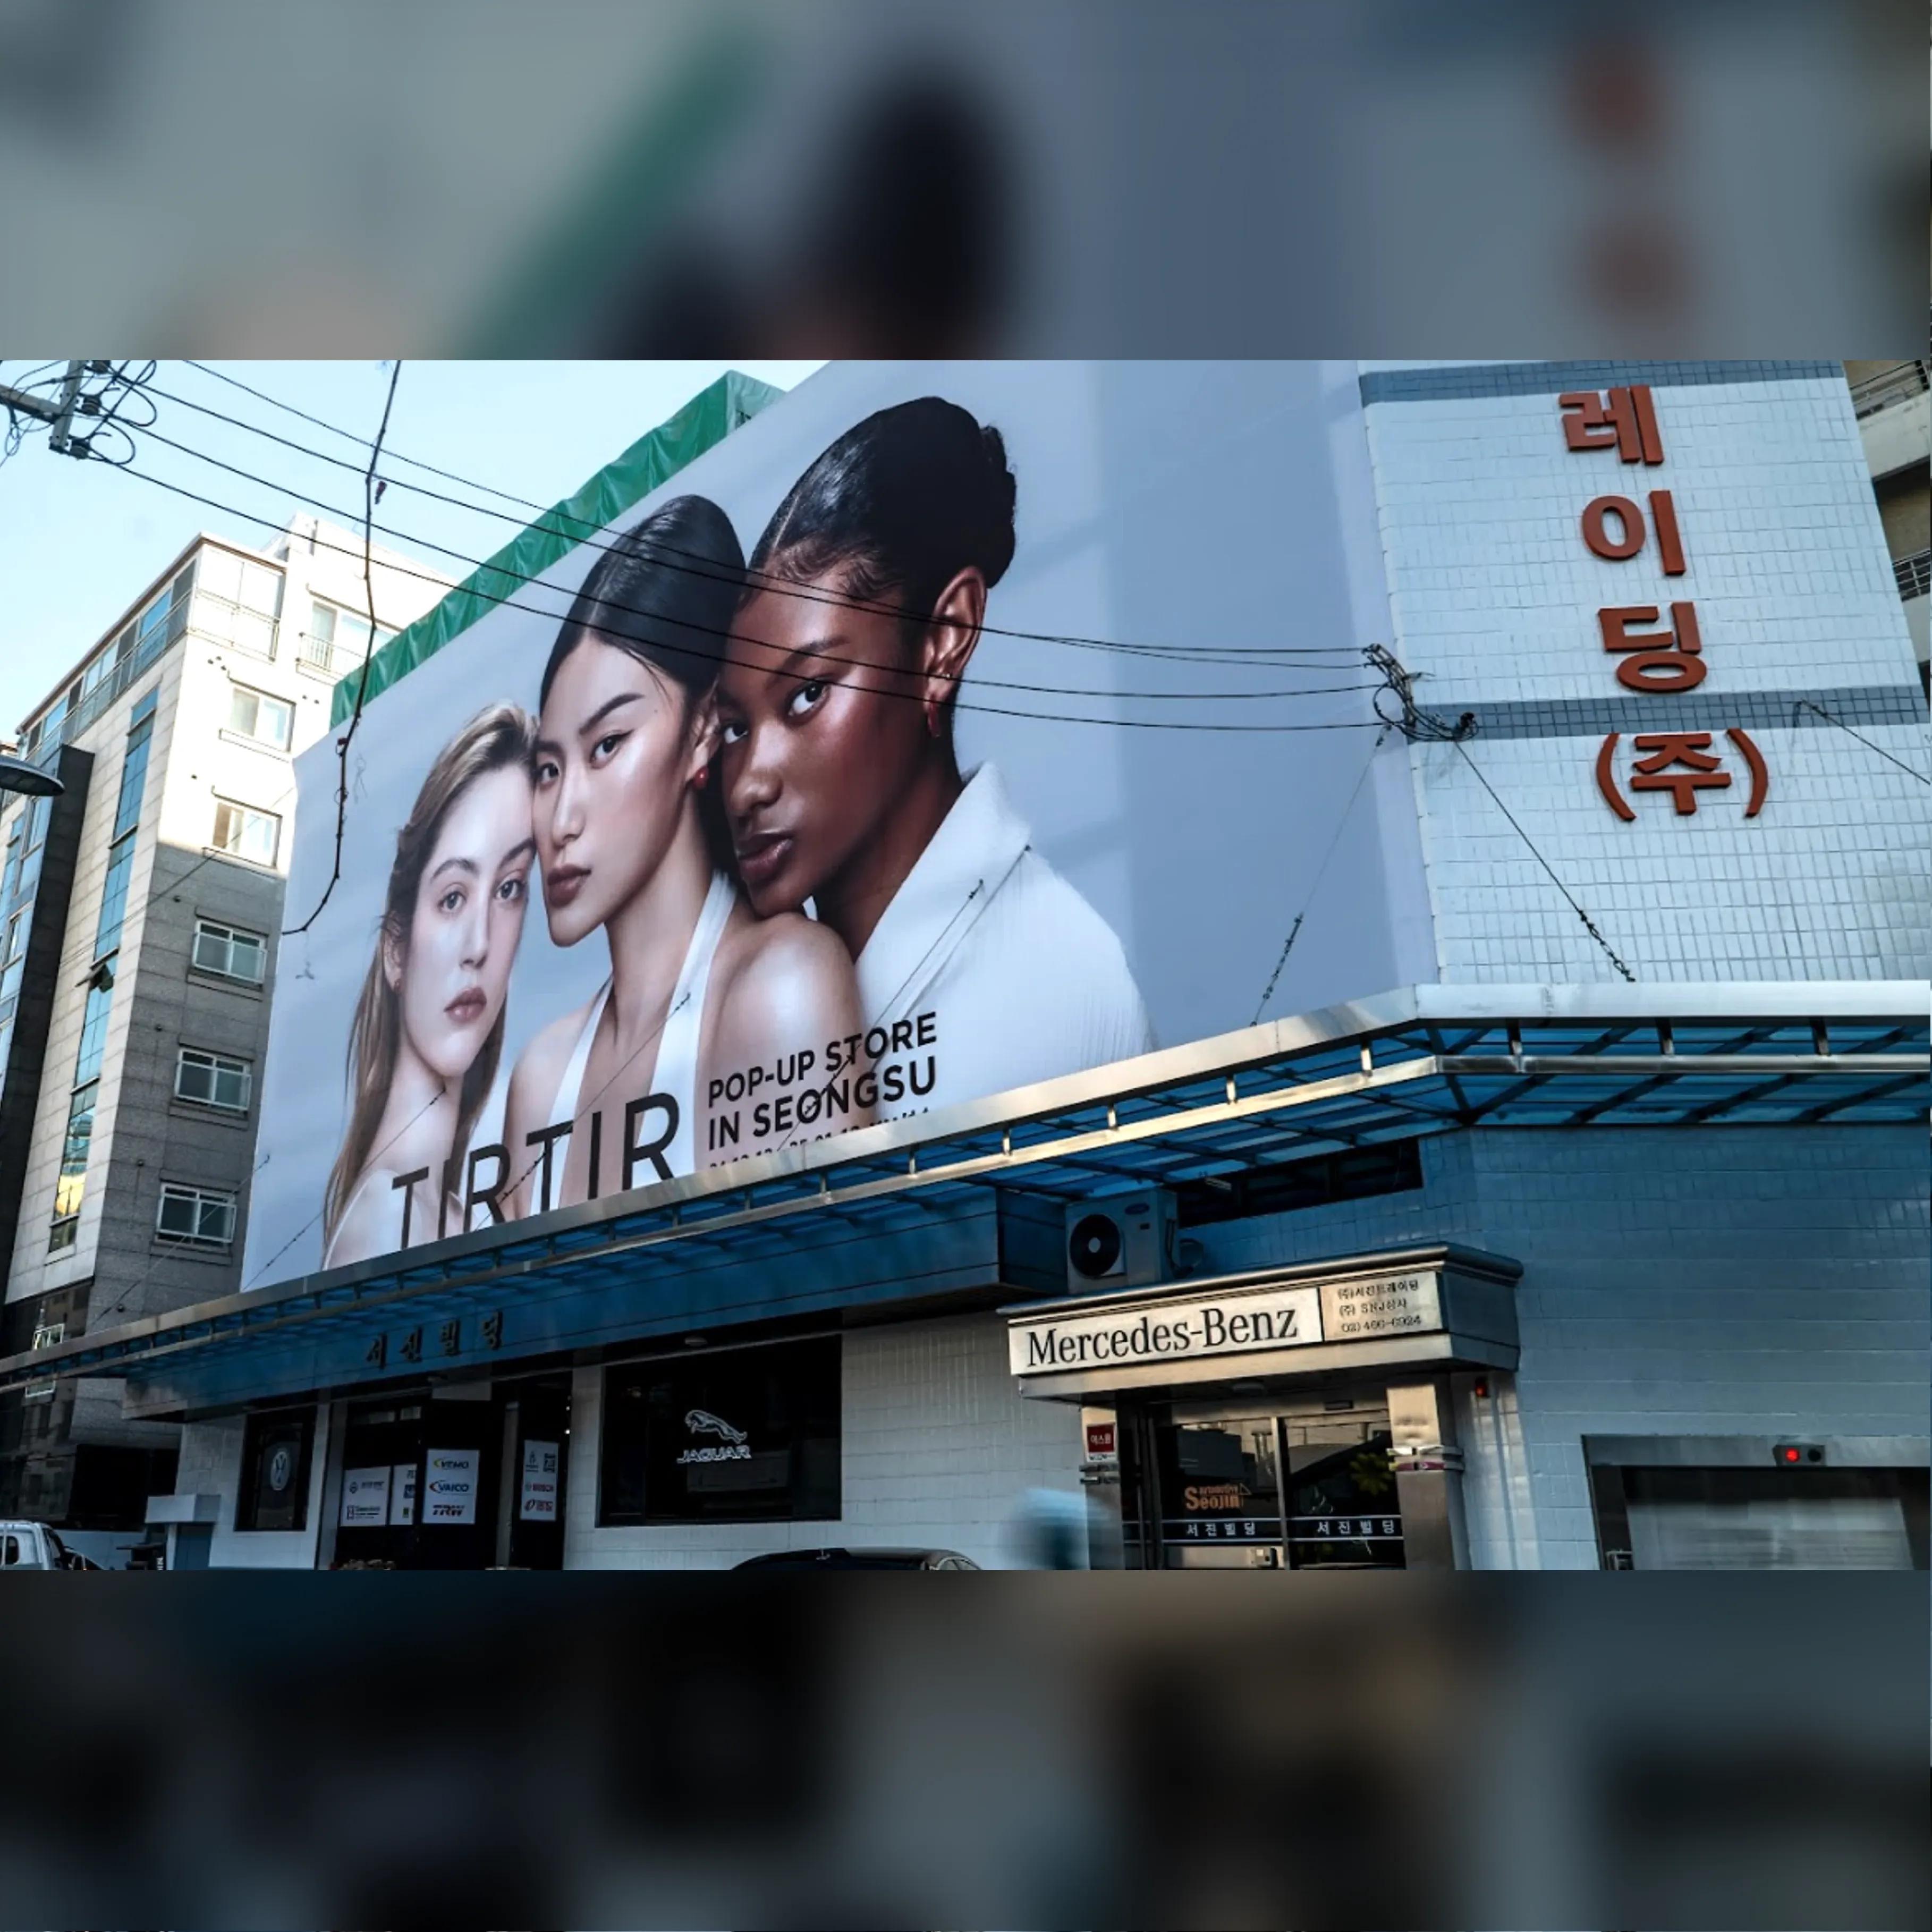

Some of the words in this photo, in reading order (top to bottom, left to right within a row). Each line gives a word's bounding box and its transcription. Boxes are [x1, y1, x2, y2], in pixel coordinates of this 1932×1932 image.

[708, 1049, 816, 1109] POP-UP
[825, 1011, 938, 1072] STORE
[709, 1111, 740, 1151] IN
[753, 1055, 935, 1137] SEONGSU
[392, 1092, 680, 1251] TIRTIR
[1027, 1307, 1299, 1368] Mercedes-Benz
[677, 1445, 752, 1464] JAGUAR
[1187, 1521, 1256, 1537] 서진빌딩
[1317, 1519, 1394, 1535] 서진빌딩
